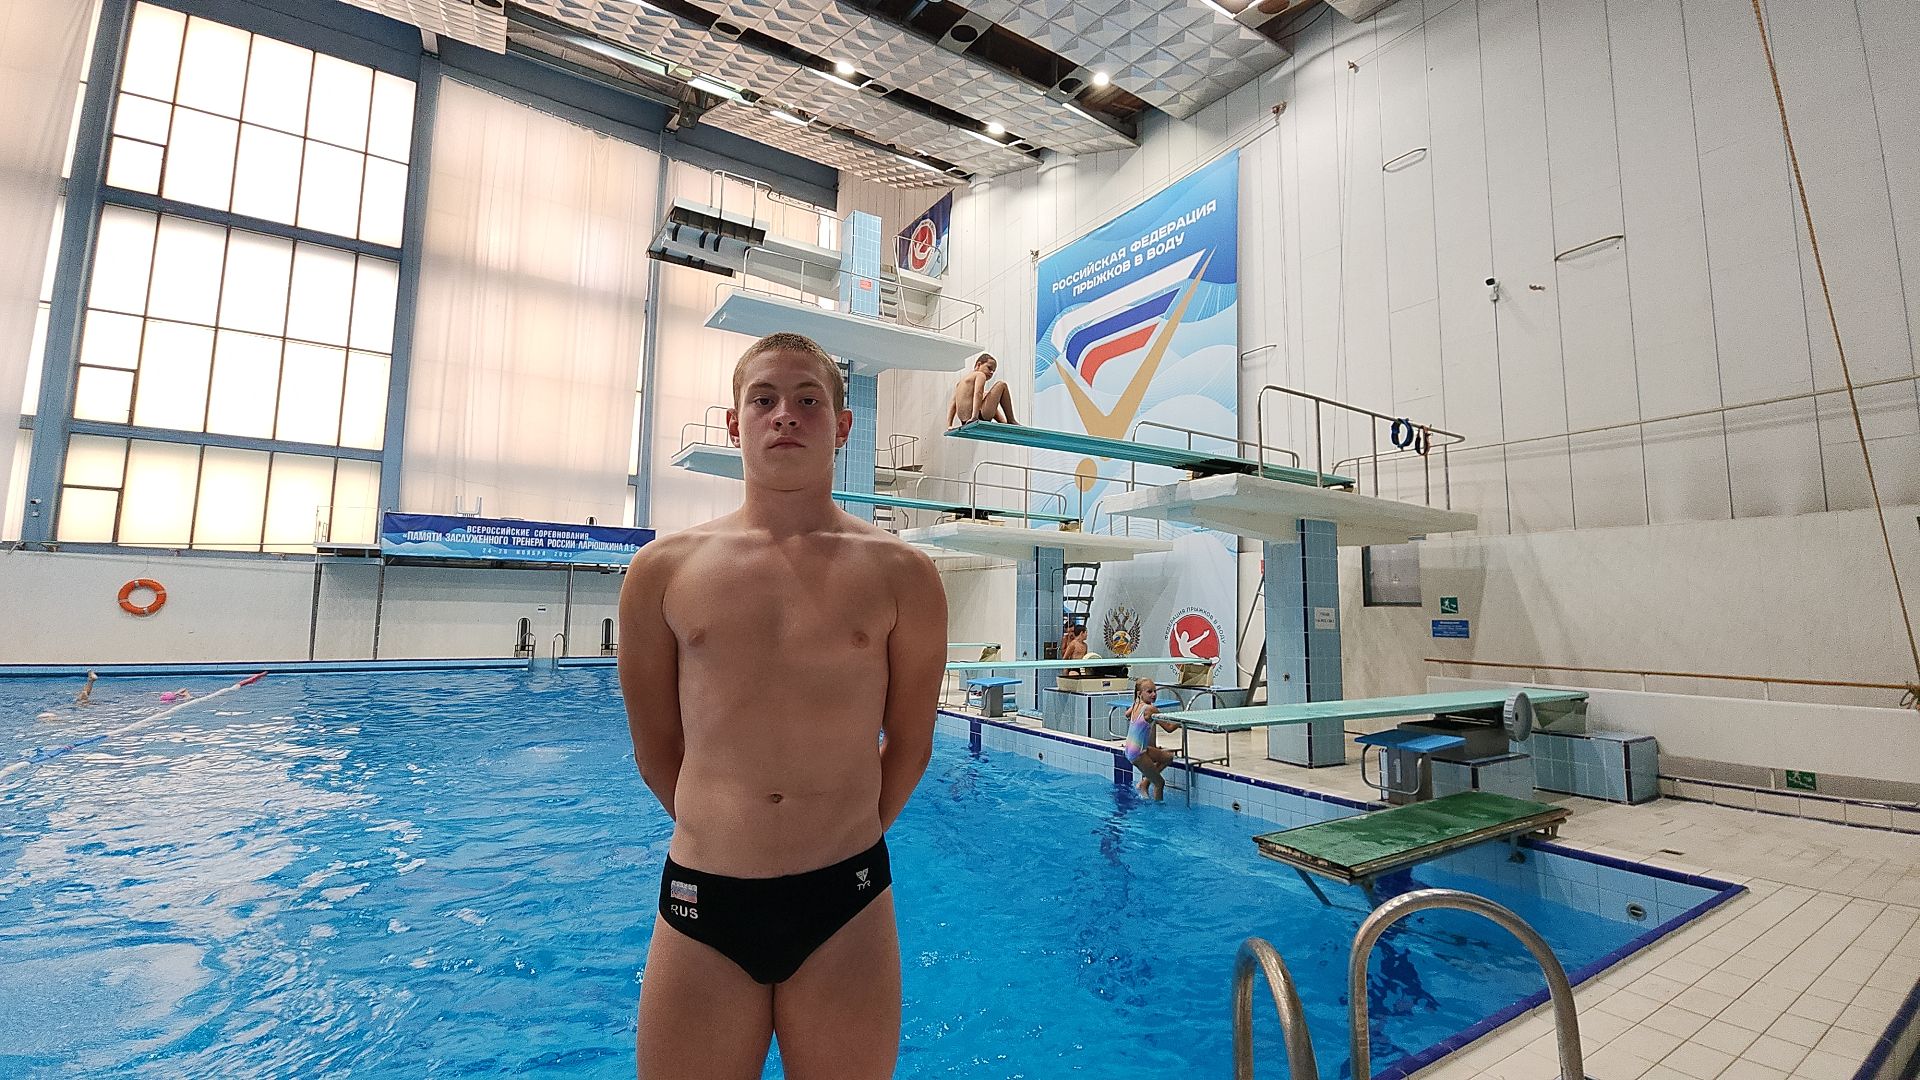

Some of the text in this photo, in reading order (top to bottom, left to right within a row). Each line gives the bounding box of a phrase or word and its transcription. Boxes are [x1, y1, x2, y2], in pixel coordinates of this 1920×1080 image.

[1052, 199, 1217, 294] РОССИЙСКАЯ ФЕДЕРАЦИЯ
[1072, 232, 1185, 296] ПРЫЖКОВ В ВОДУ
[403, 531, 442, 541] «ПАМЯТИ
[445, 533, 508, 545] ЗАСЛУЖЕННОГО
[512, 536, 544, 547] ТРЕНЕРА
[547, 538, 576, 549] РОССИИ
[578, 540, 623, 552] ЛАРЮШКИНА
[467, 525, 589, 540] ВСЕРОССИЙСКИЕ СОРЕВНОВАНИЯ
[1164, 608, 1186, 640] ФЕДЕРАЦИЯ
[1186, 606, 1213, 620] ПРЫЖКОВ
[1216, 624, 1226, 644] ВОДУ
[856, 880, 871, 891] TYR
[670, 904, 698, 919] RUS
